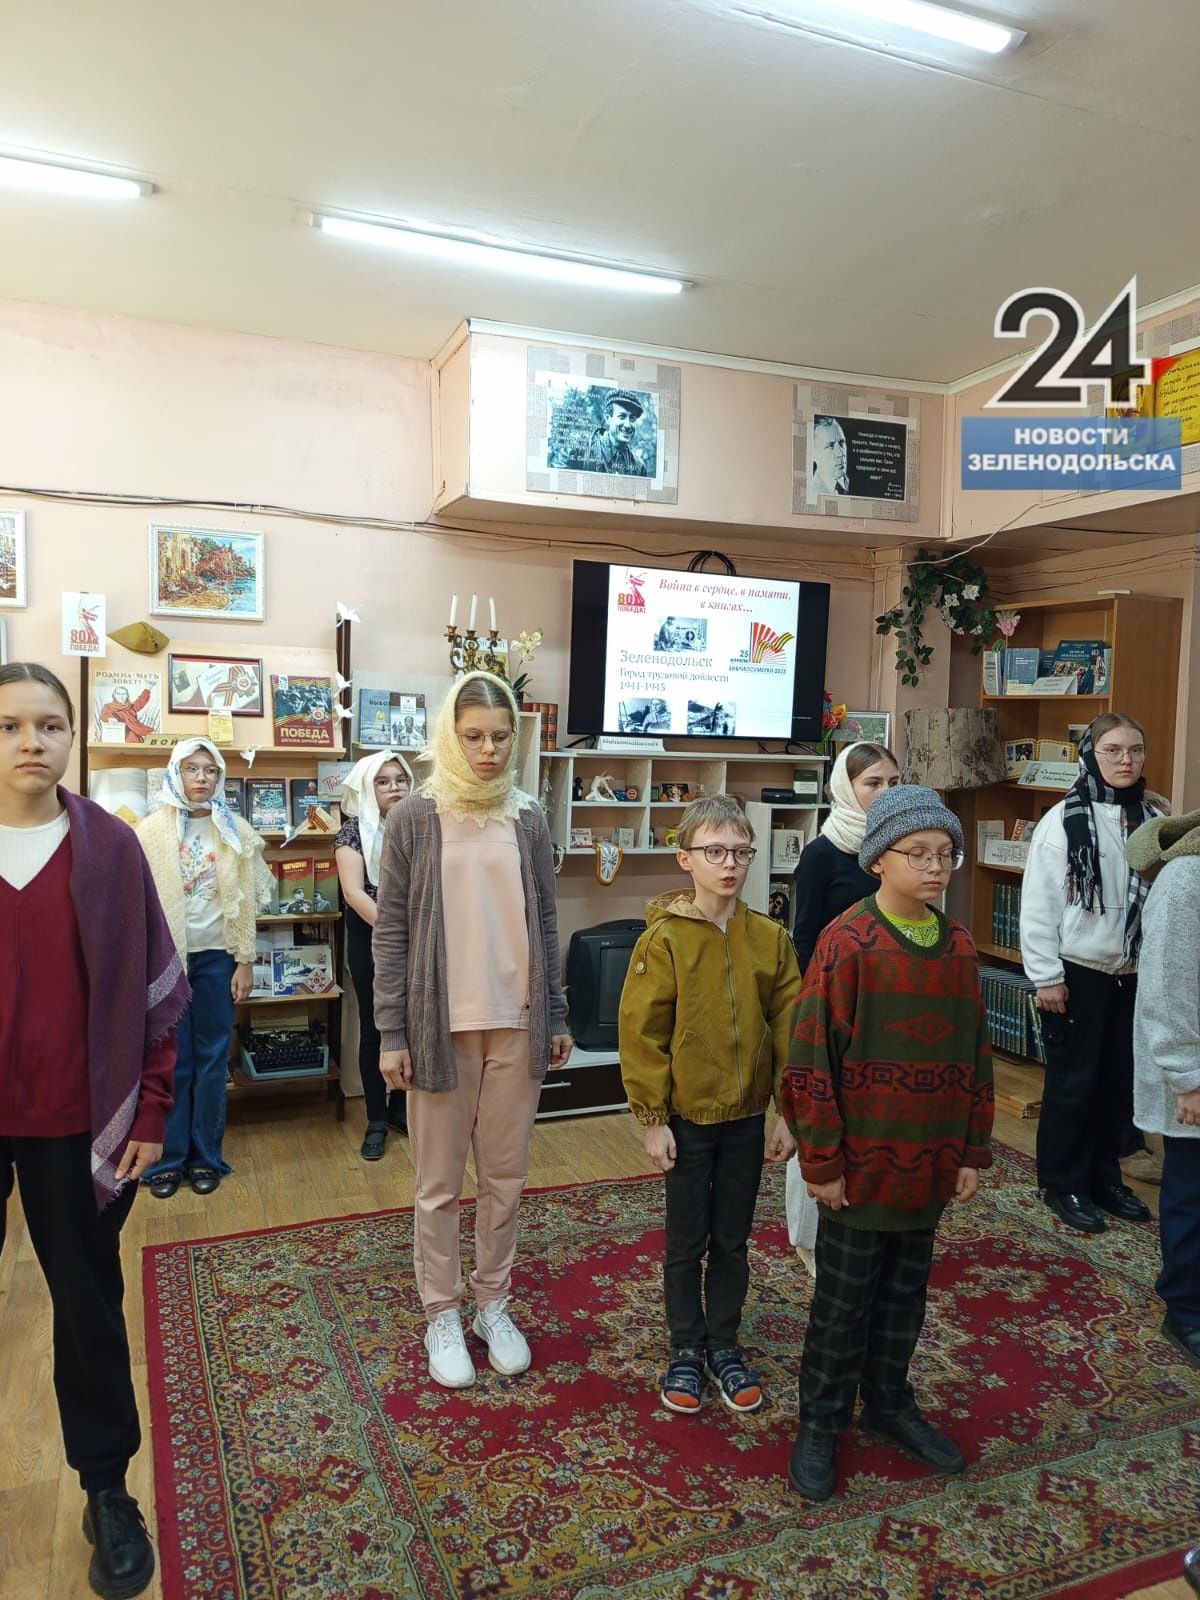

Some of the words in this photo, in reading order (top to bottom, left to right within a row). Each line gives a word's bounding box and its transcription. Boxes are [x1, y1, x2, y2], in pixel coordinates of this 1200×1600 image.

[659, 578, 692, 592] Война
[618, 593, 633, 605] 80
[700, 601, 705, 609] в
[70, 630, 86, 641] 80
[620, 650, 713, 668] Зеленодольск
[620, 668, 646, 678] Город
[648, 672, 687, 681] трудовой
[689, 672, 729, 682] доблести
[620, 682, 666, 692] 1941-1945
[280, 728, 329, 739] ПОБЕДА
